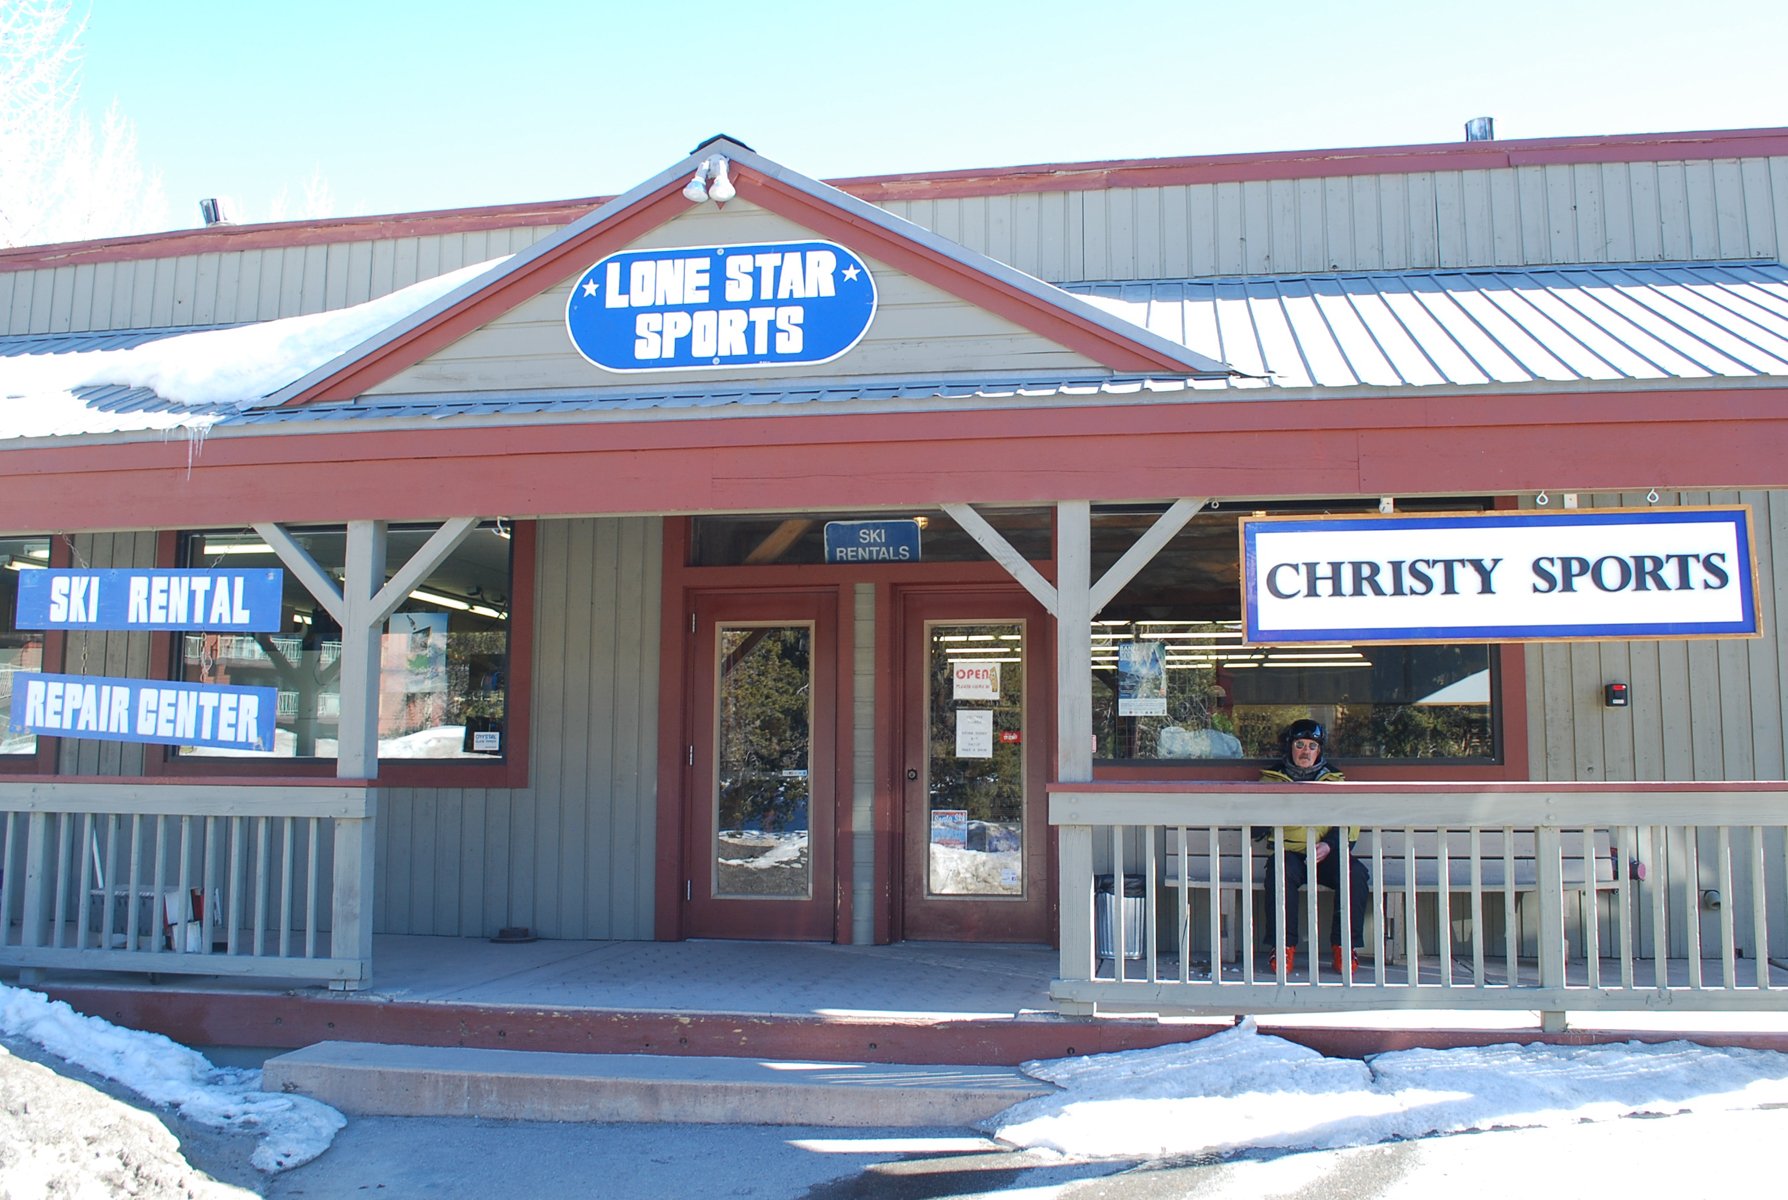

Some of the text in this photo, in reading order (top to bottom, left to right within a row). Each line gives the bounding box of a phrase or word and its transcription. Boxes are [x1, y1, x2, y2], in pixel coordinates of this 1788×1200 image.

[605, 250, 837, 309] LONE STAR
[634, 305, 804, 360] SPORTS
[836, 545, 910, 561] RENTALS
[859, 528, 886, 543] SKI
[1265, 552, 1729, 599] CHRISTY SPORTS
[49, 576, 250, 624] SKI RENTAL
[956, 669, 989, 680] OPEN
[24, 680, 260, 743] REPAIR CENTER
